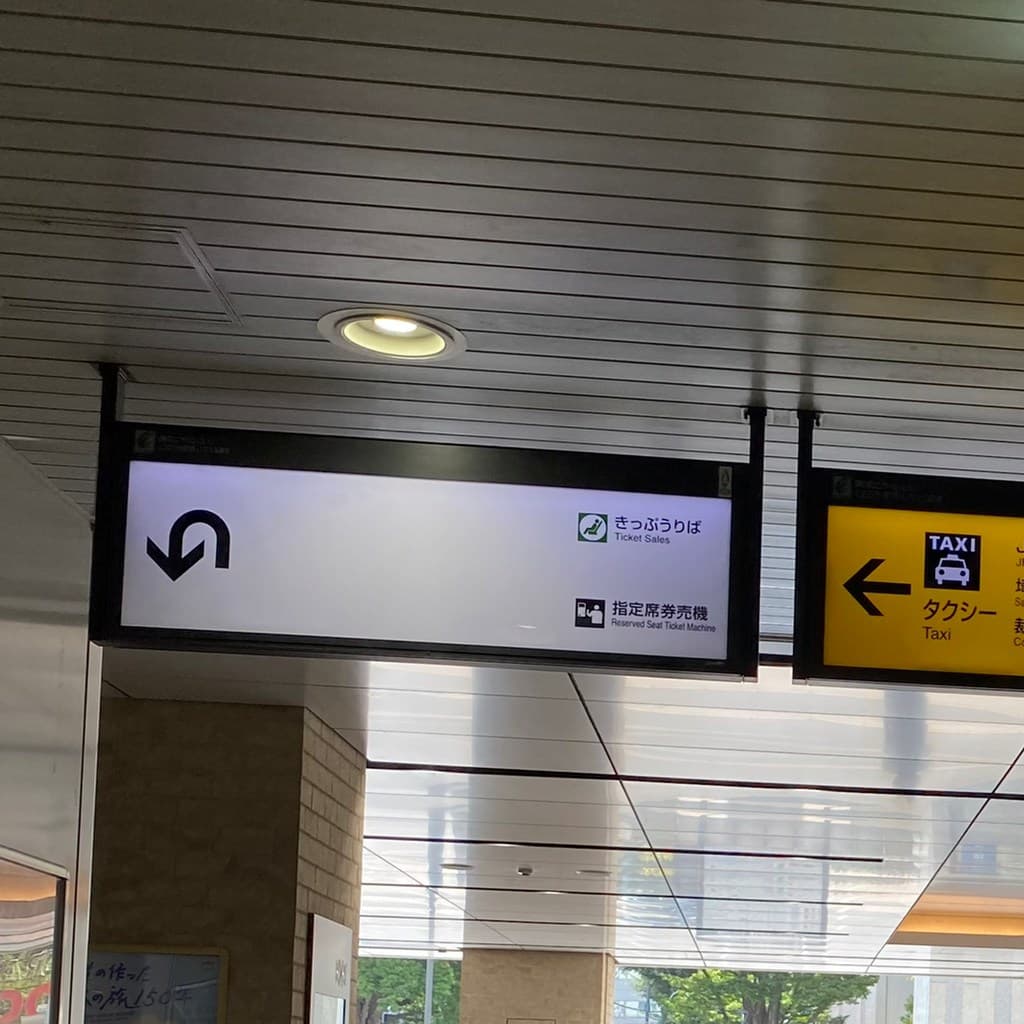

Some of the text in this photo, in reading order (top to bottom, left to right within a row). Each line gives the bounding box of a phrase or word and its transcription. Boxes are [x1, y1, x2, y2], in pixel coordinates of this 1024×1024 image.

[615, 516, 702, 534] きっぷうりば
[614, 532, 671, 544] Ticket Sales
[929, 535, 976, 552] TAXI
[612, 600, 709, 621] 指定席券売機
[923, 598, 997, 622] タクシー
[611, 618, 716, 633] Reserved Seat Ticket Machine
[923, 626, 951, 641] Taxi
